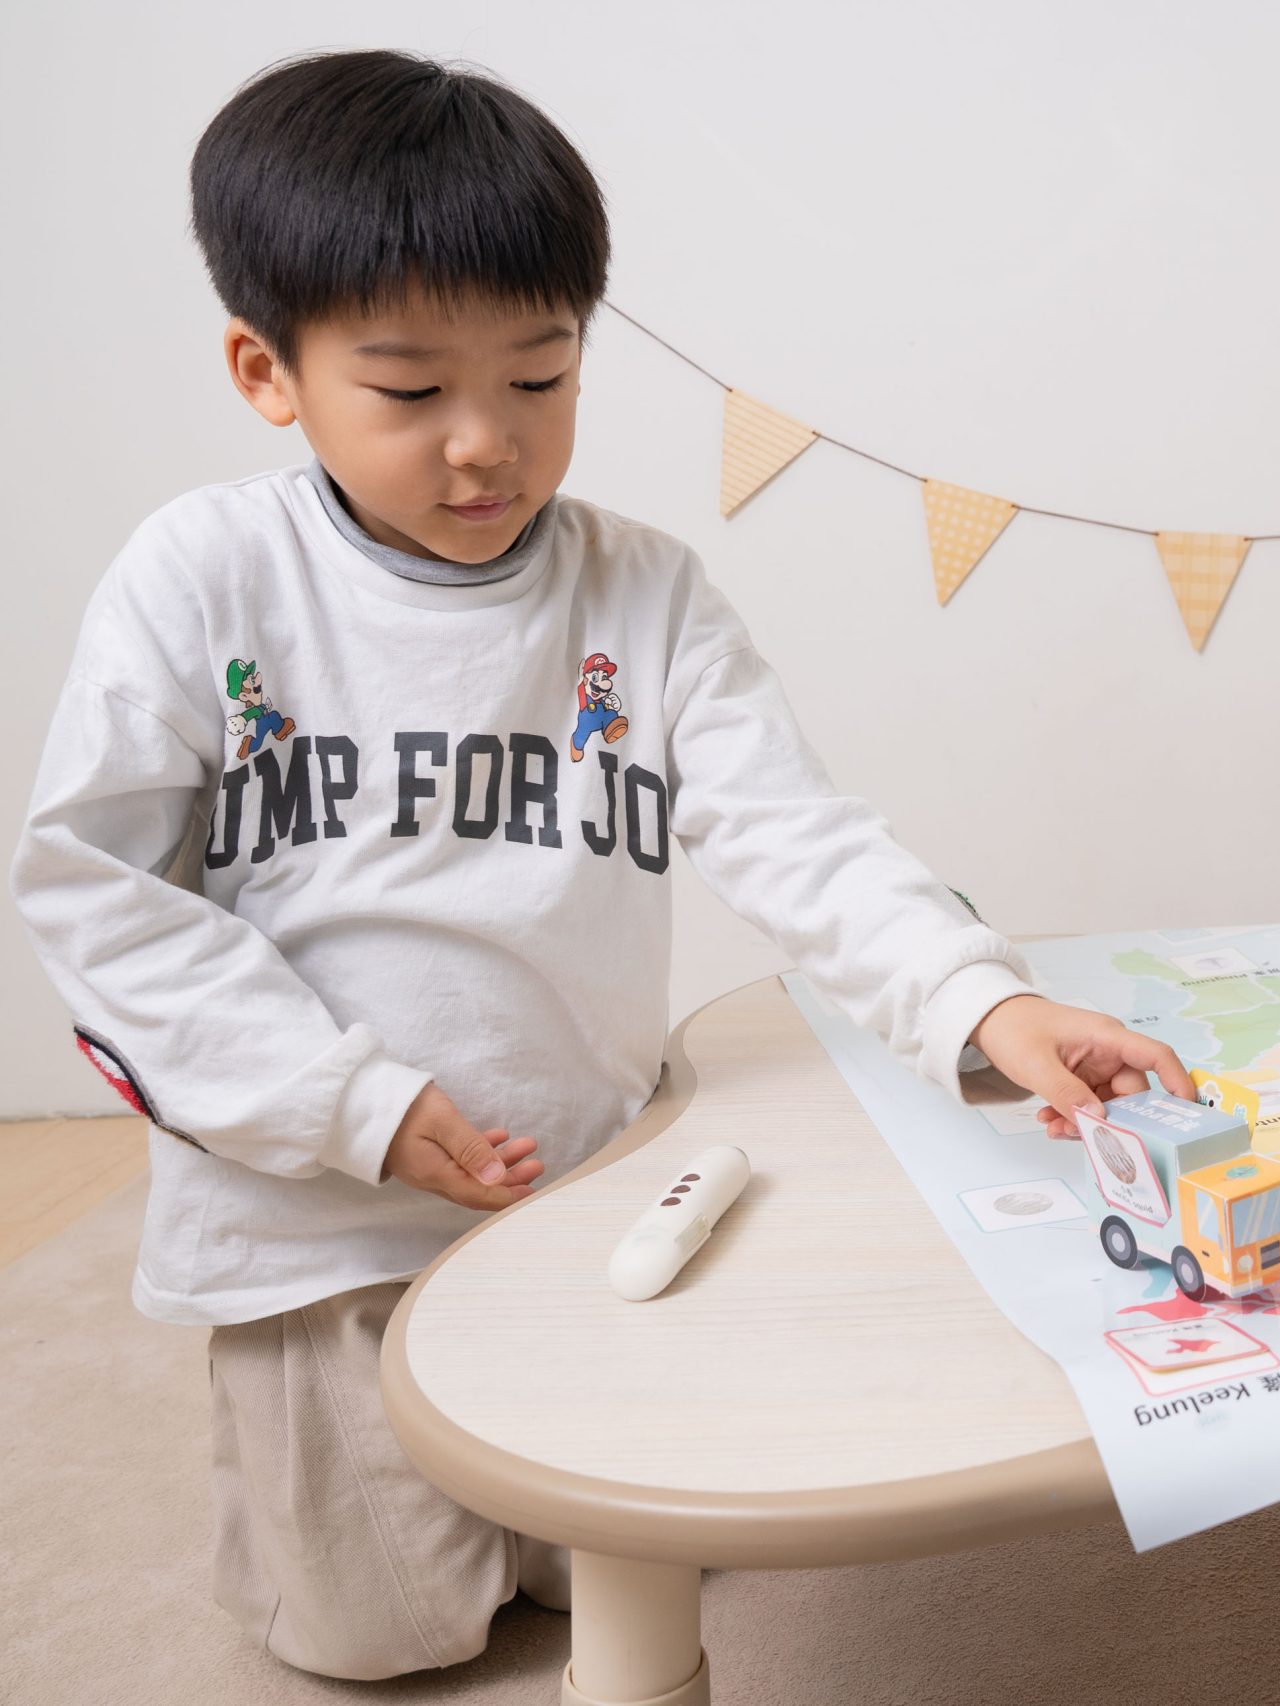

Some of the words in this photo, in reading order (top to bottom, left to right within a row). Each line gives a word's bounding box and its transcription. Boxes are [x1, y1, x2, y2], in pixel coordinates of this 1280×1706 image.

[390, 732, 563, 849] FOR
[581, 751, 670, 875] JO
[1133, 1380, 1251, 1428] Keelung
